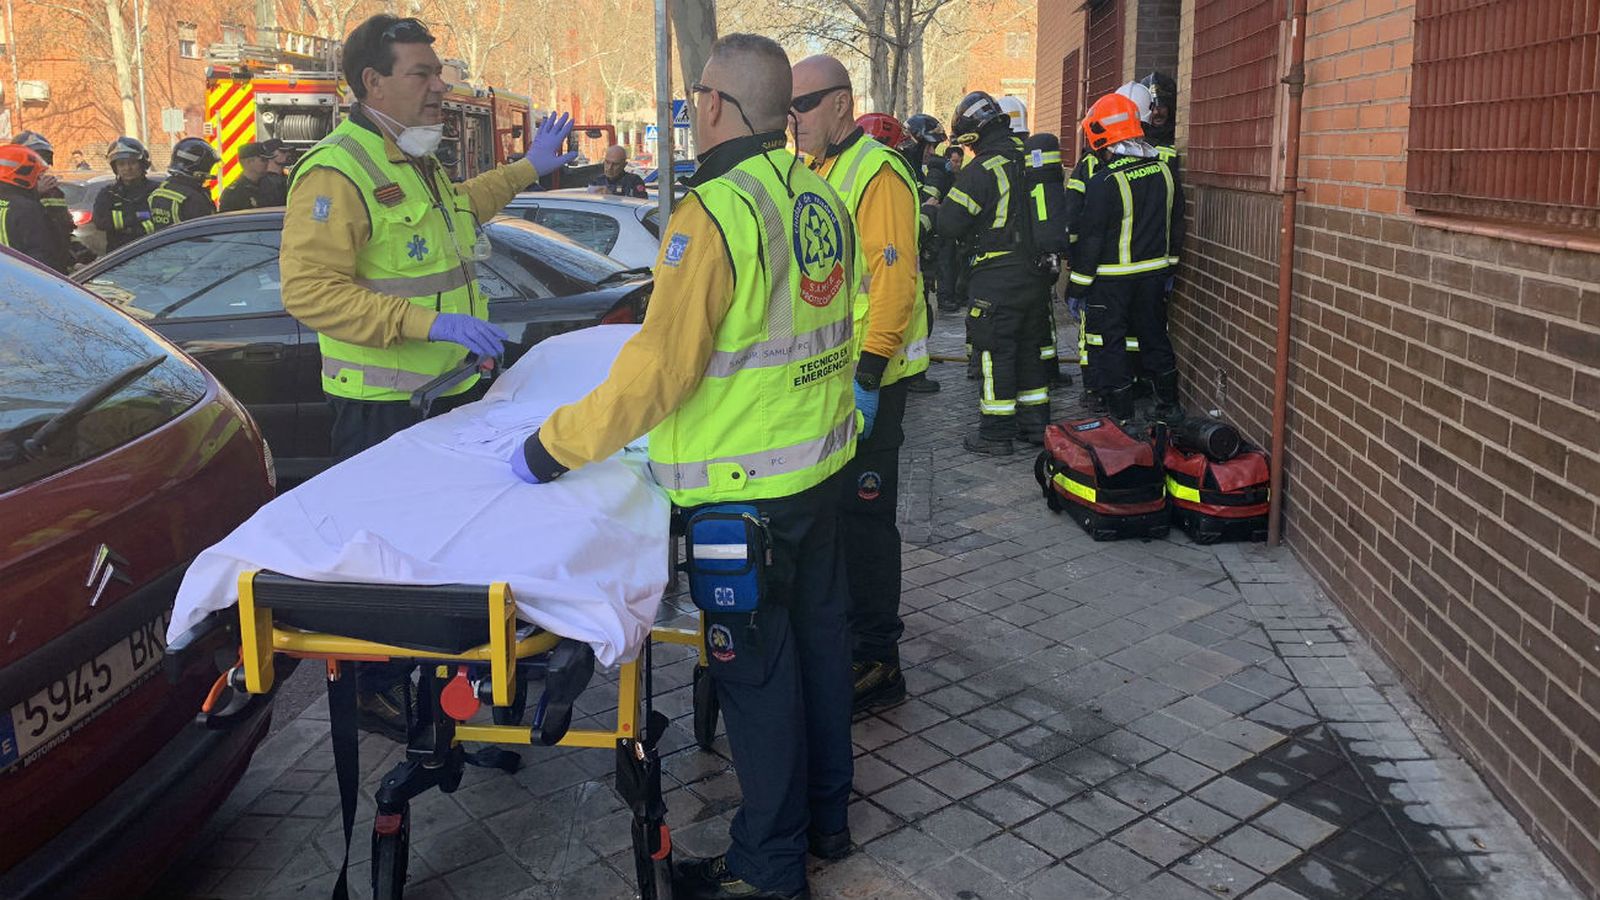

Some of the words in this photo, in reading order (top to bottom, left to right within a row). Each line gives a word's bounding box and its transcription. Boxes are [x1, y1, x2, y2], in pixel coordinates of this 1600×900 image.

[1126, 164, 1161, 181] MADRID
[1030, 183, 1048, 221] 1
[793, 357, 850, 387] EMERGENCIA
[800, 353, 839, 374] TECNICO
[23, 659, 112, 738] 5945
[2, 739, 12, 755] E
